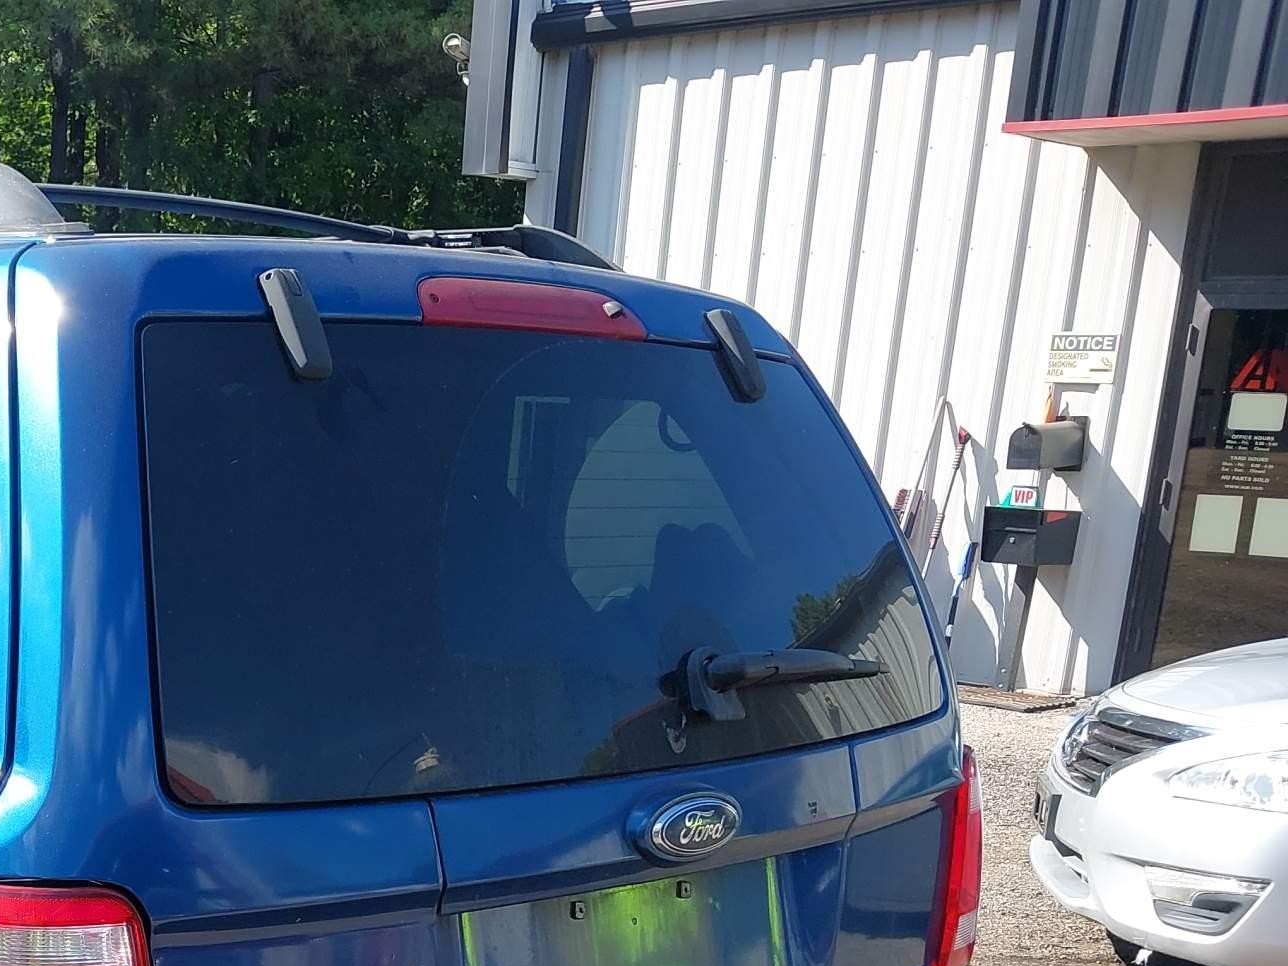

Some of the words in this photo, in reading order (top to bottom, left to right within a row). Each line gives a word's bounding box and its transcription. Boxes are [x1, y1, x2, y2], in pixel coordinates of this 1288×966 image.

[1053, 336, 1115, 350] NOTICE
[1048, 352, 1089, 361] DESIGNATED
[1047, 360, 1077, 369] SMOKING
[1046, 368, 1064, 377] AREA
[1014, 489, 1034, 504] VIP
[680, 810, 725, 844] Ford
